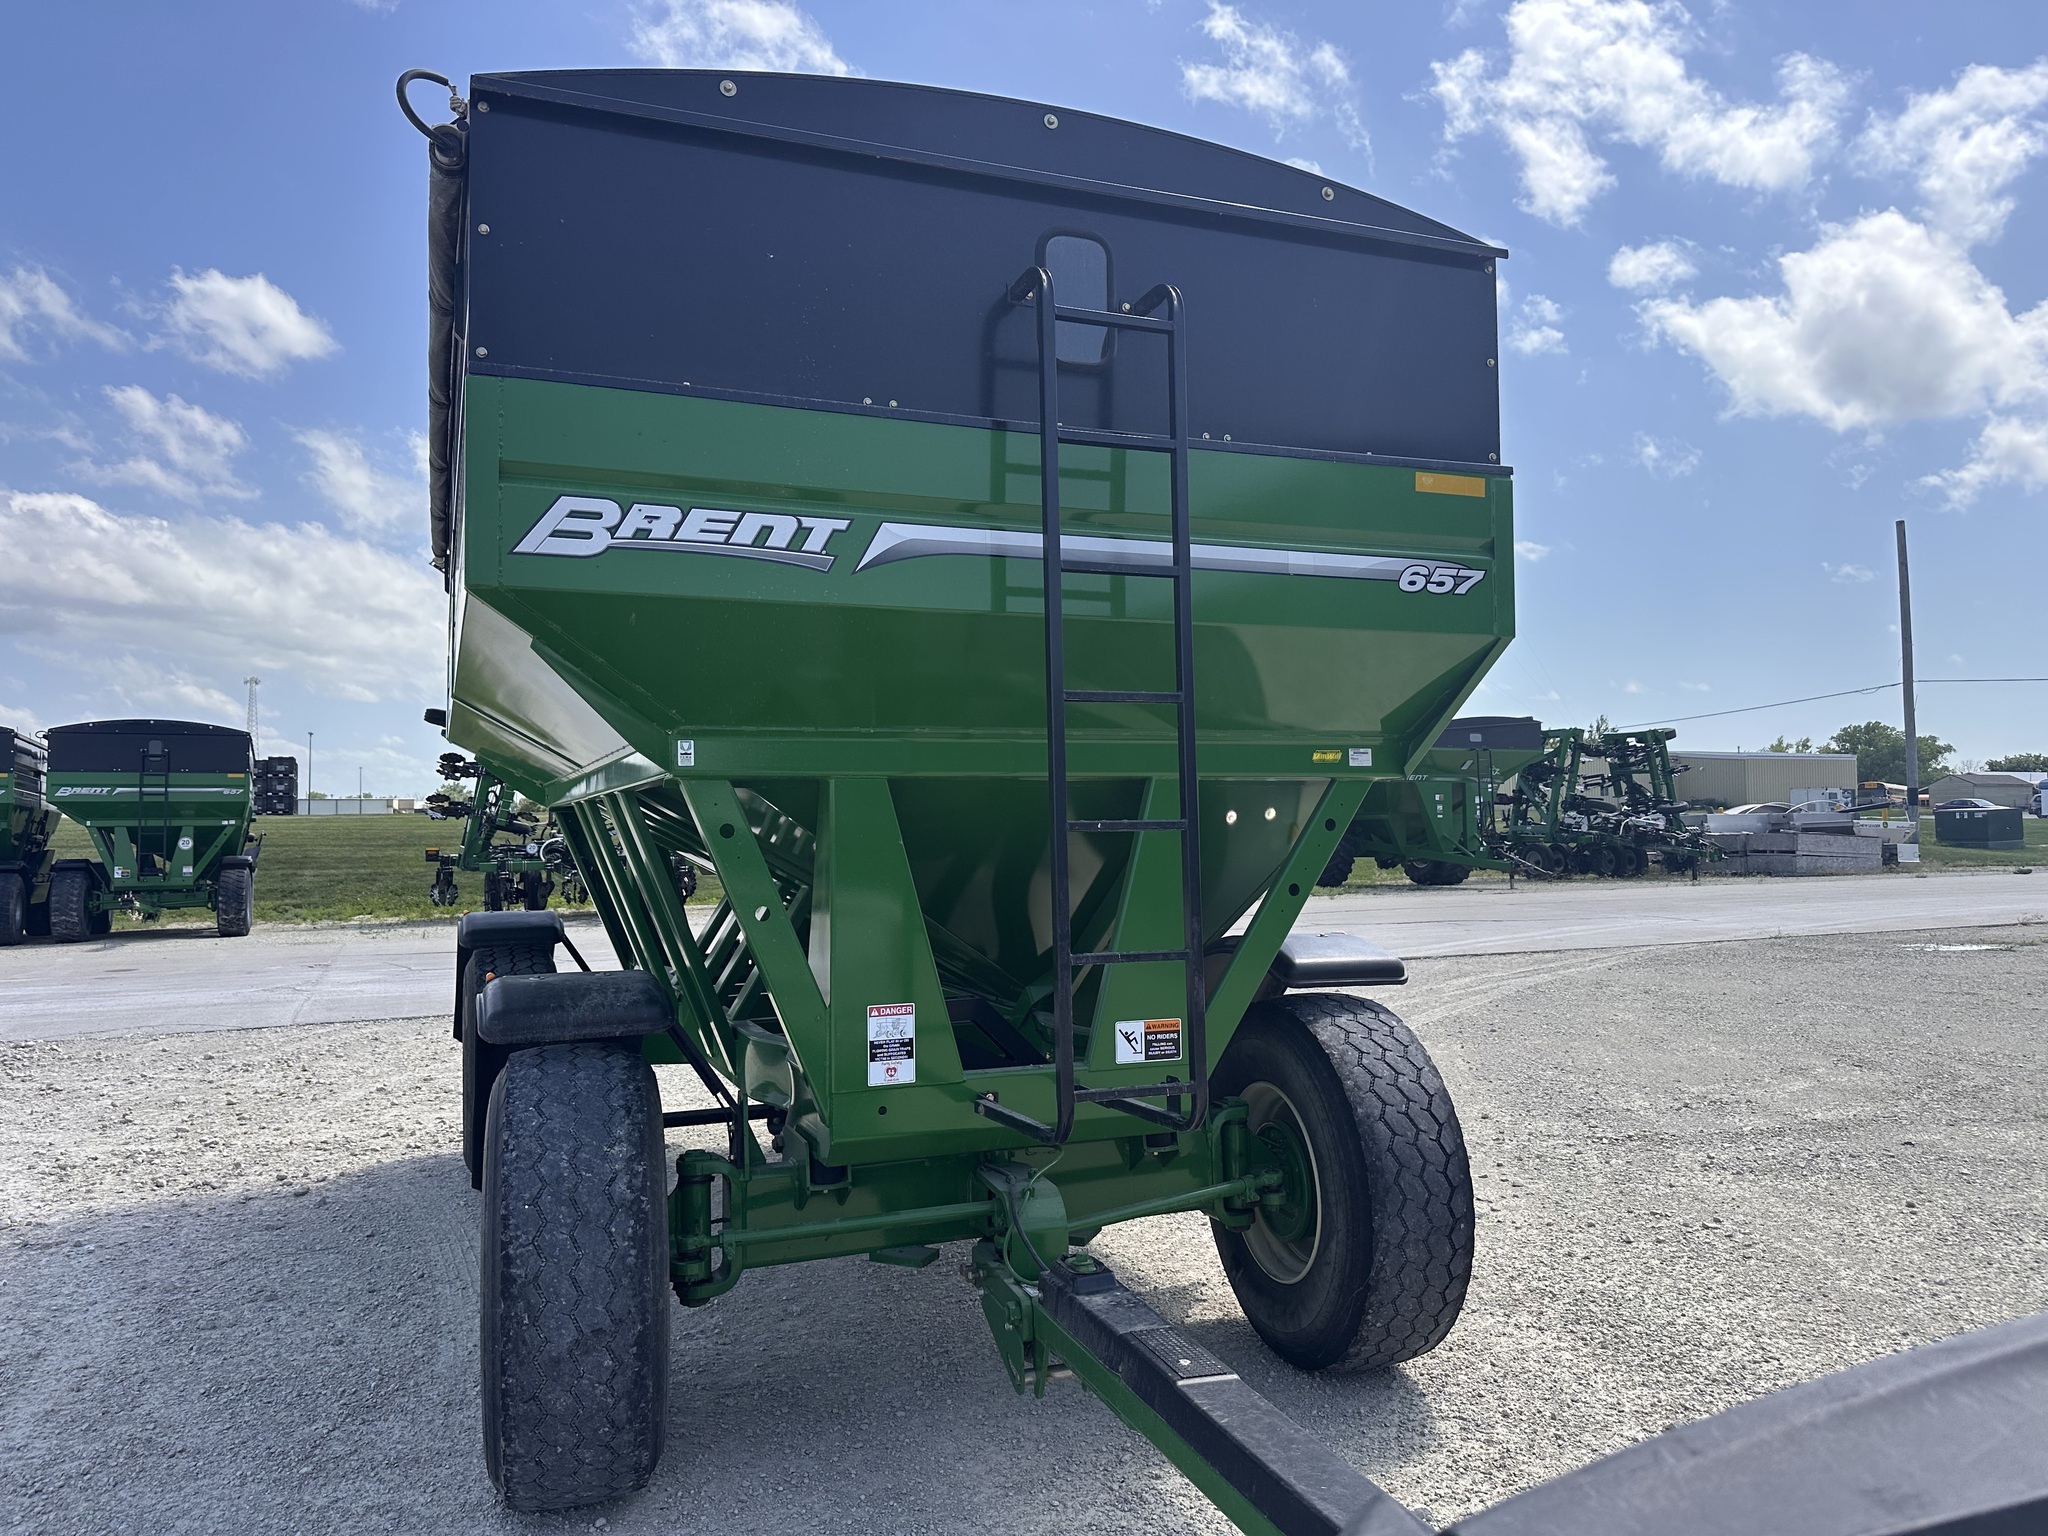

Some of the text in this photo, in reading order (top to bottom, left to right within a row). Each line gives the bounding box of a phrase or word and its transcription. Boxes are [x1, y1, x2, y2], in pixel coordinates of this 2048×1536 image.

[511, 494, 853, 559] BRENT
[1398, 565, 1487, 595] 657
[54, 786, 112, 797] BRENT
[880, 1006, 912, 1016] DANGER
